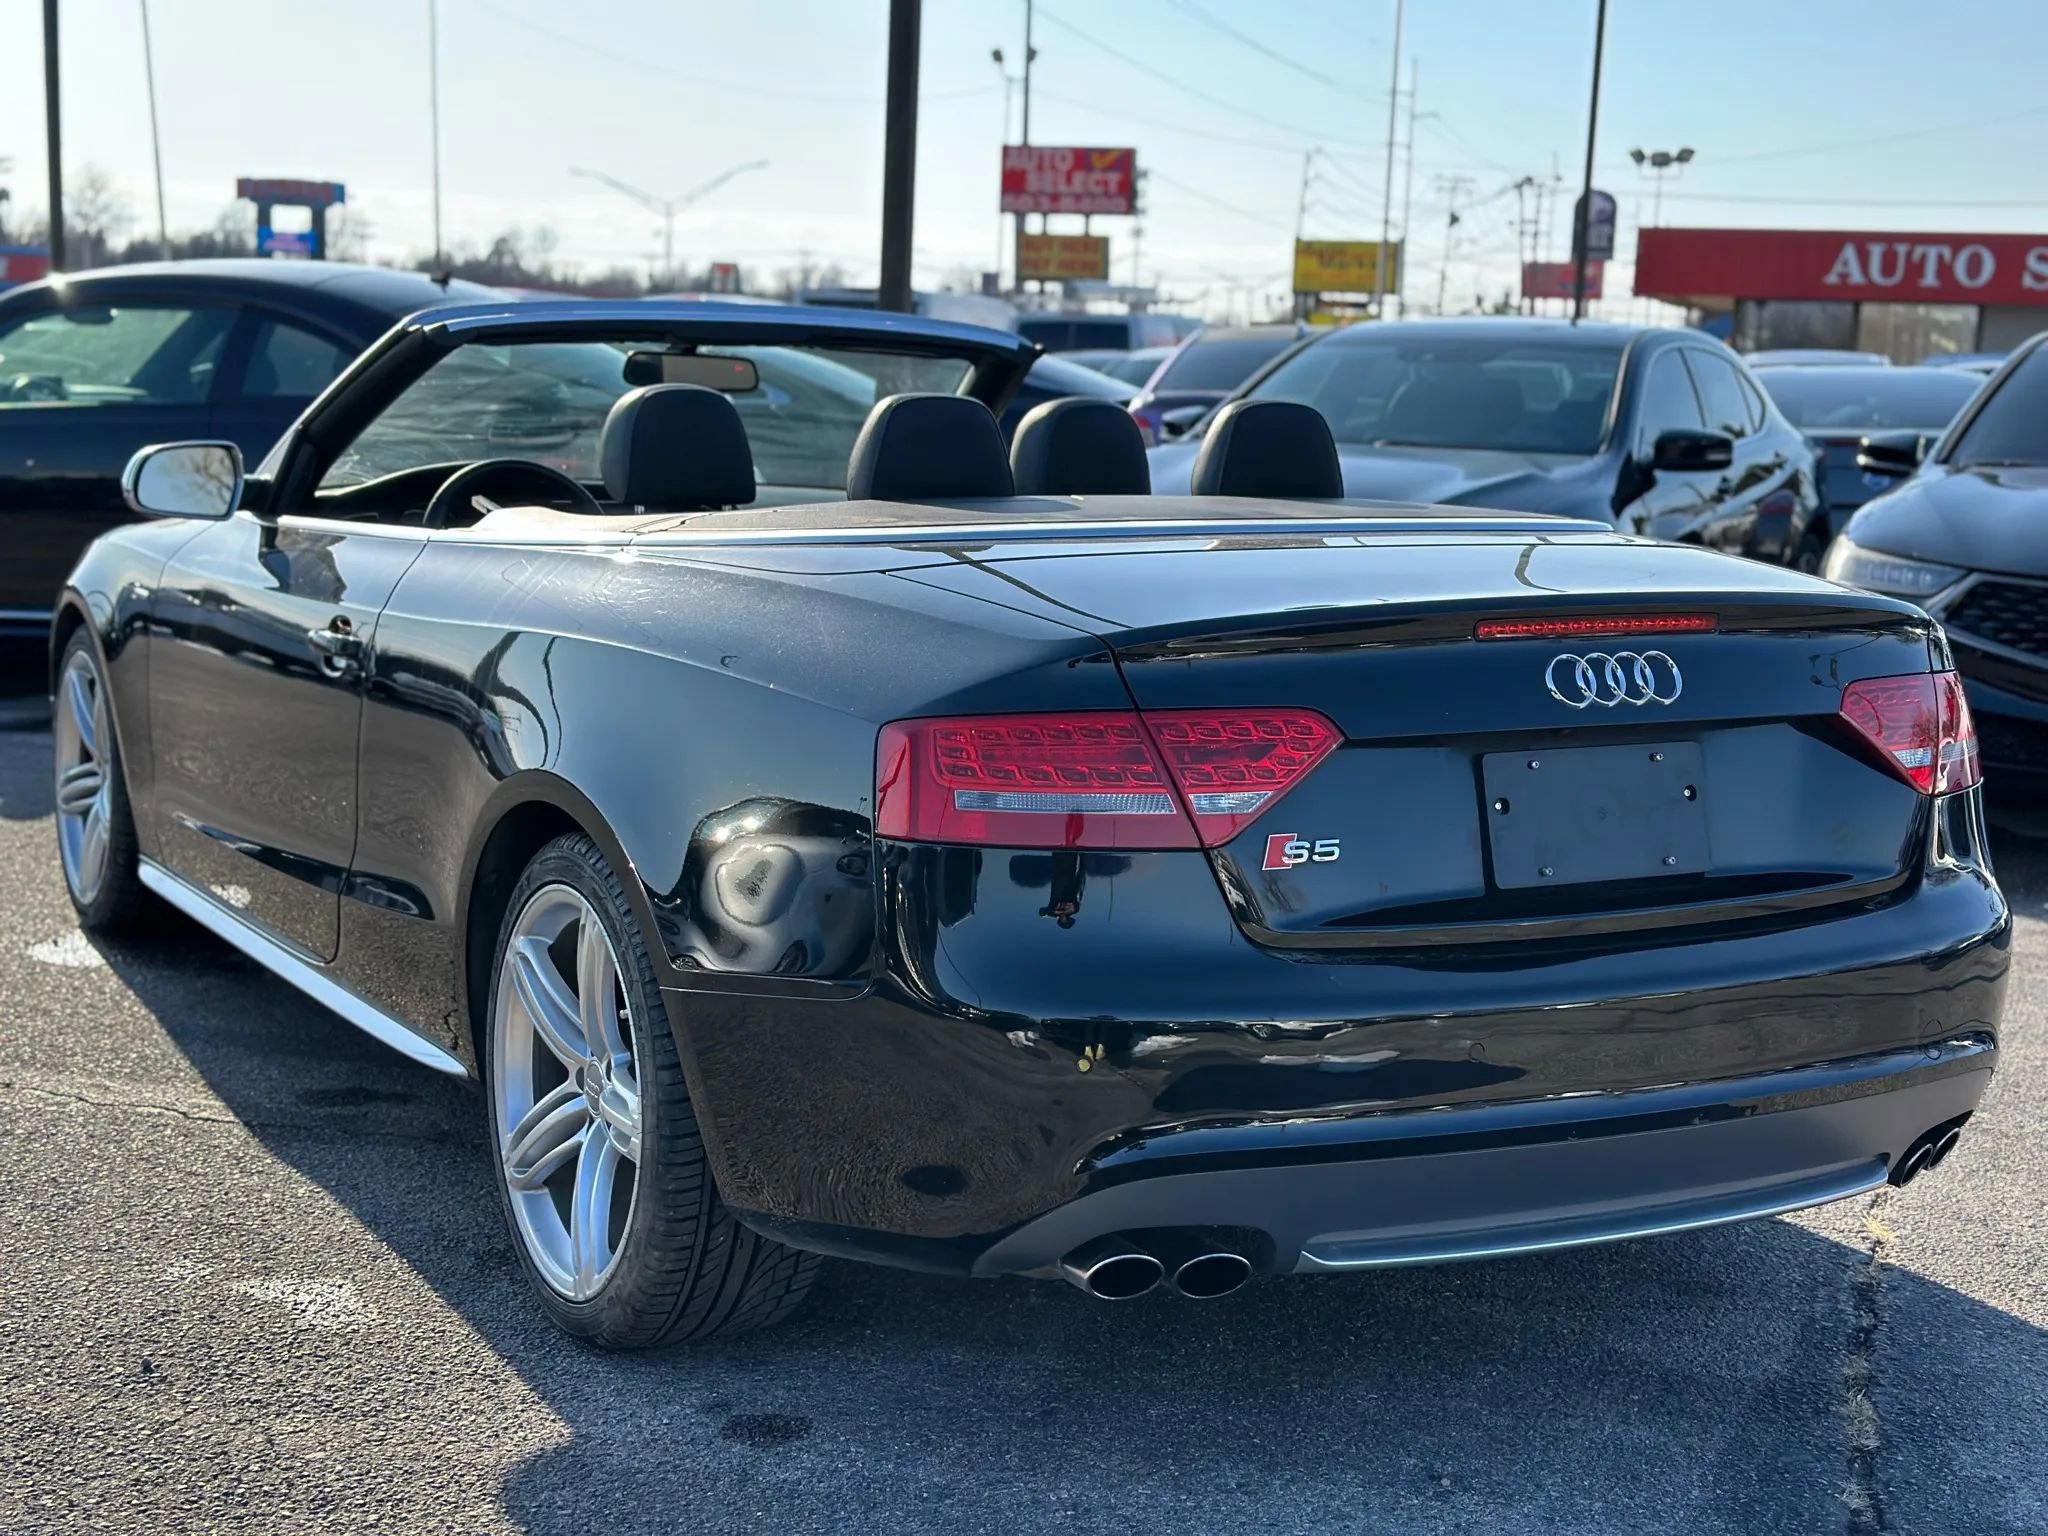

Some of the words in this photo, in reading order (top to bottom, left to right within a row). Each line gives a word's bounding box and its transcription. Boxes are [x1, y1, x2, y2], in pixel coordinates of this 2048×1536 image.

[1005, 148, 1075, 170] AUTO
[1024, 170, 1124, 194] SELECT
[1824, 242, 1996, 288] AUTO
[1281, 838, 1341, 864] S5
